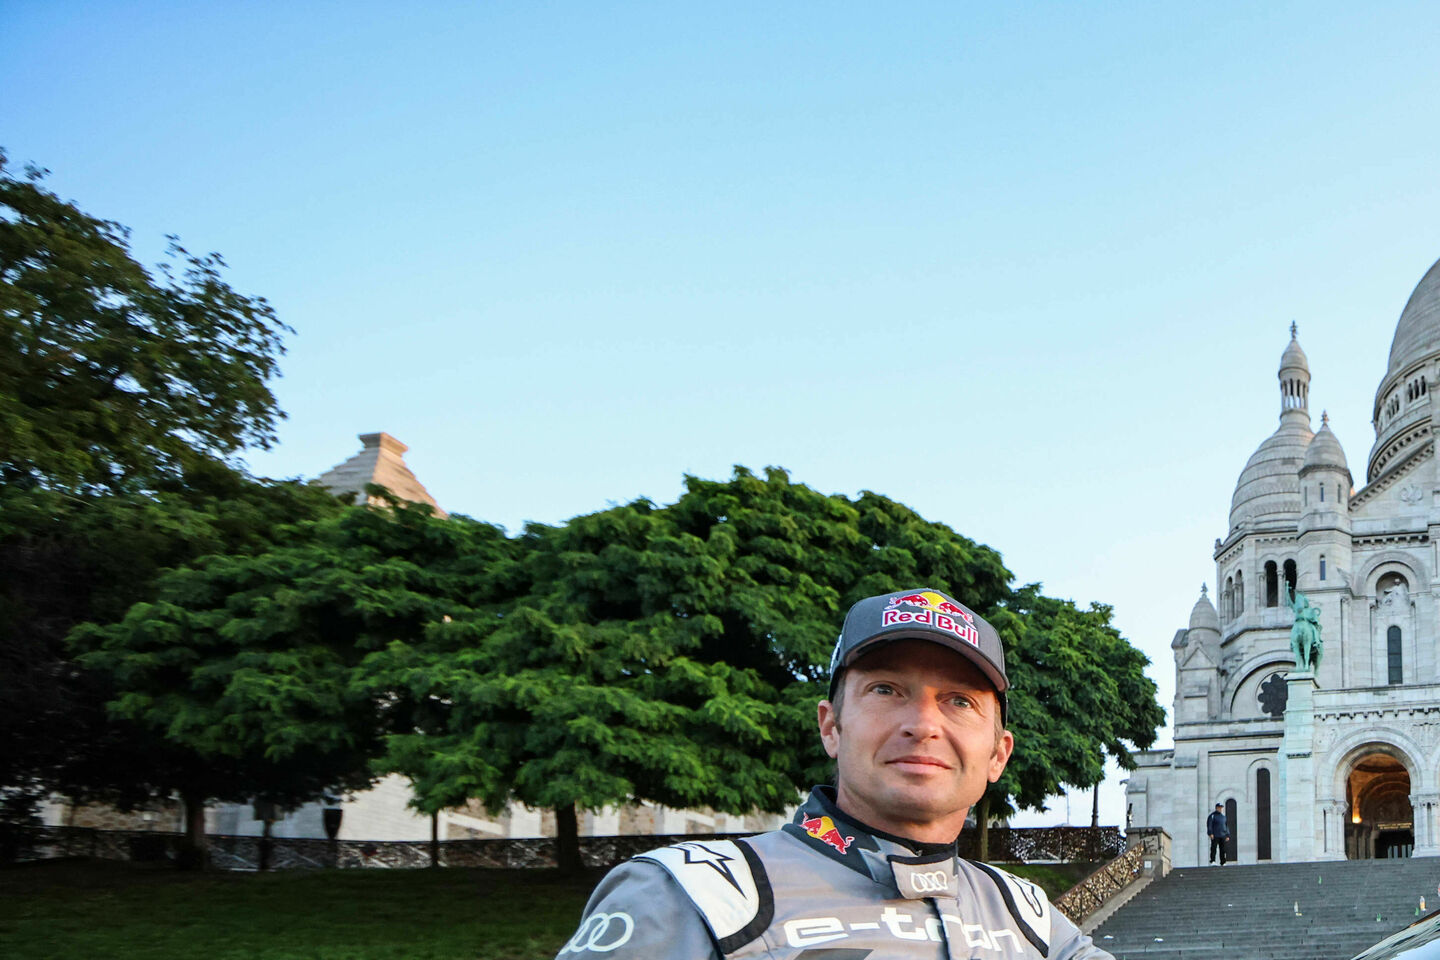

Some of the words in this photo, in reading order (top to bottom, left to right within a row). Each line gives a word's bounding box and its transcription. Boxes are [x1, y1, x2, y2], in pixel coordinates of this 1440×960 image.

[882, 609, 933, 628] Red
[935, 612, 979, 648] Bull
[784, 906, 1024, 954] e-tron
